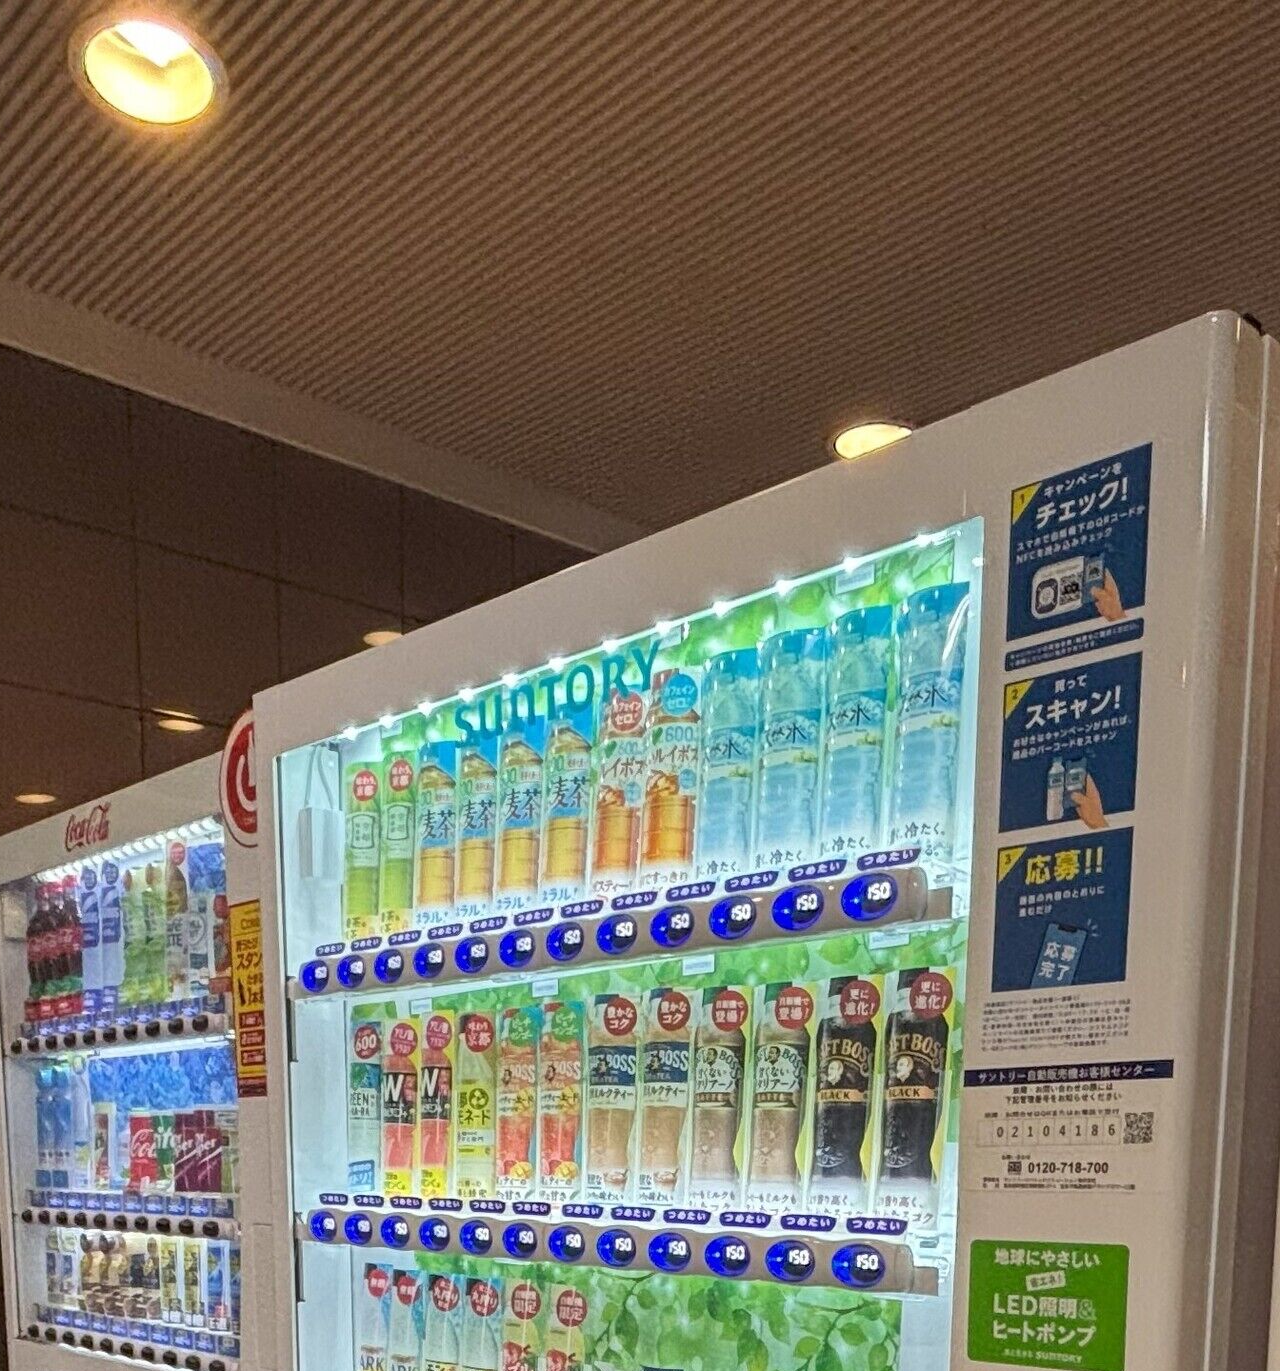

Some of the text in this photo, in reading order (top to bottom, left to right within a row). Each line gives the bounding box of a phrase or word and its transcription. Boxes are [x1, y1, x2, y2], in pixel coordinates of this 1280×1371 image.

[1043, 462, 1122, 498] キャンペーンを
[1036, 476, 1128, 530] チェック!
[1054, 673, 1088, 694] 買って
[454, 641, 661, 749] SUNTORY
[1025, 686, 1120, 730] スキャン!
[554, 776, 591, 807] 麦茶
[505, 788, 541, 821] 麦茶
[463, 800, 496, 830] 麦茶
[423, 810, 455, 839] 麦茶
[860, 851, 916, 870] つめたい
[1025, 846, 1103, 885] 応募!!
[791, 862, 845, 882] つめたい
[728, 873, 777, 892] つめたい
[669, 884, 714, 901] つめたい
[867, 882, 891, 901] 150
[615, 894, 656, 910] つめたい
[796, 893, 819, 911] 150
[671, 913, 690, 929] 150
[731, 905, 751, 921] 150
[1039, 961, 1070, 981] 完了
[849, 989, 870, 1000] 更に
[920, 980, 941, 993] 更に
[913, 995, 947, 1010] 進化!
[609, 1018, 630, 1030] コク
[662, 1013, 683, 1024] コク
[1028, 1161, 1109, 1174] 0120-718-700
[614, 1209, 653, 1221] つめたい
[667, 1211, 710, 1224] つめたい
[723, 1214, 770, 1228] つめたい
[784, 1217, 835, 1231] つめたい
[850, 1219, 905, 1235] つめたい
[669, 1241, 687, 1256] 150
[726, 1246, 746, 1260] 150
[788, 1250, 810, 1266] 150
[856, 1254, 879, 1270] 150
[995, 1249, 1101, 1267] 地球にやさしい
[992, 1323, 1096, 1347] ヒートポンプ
